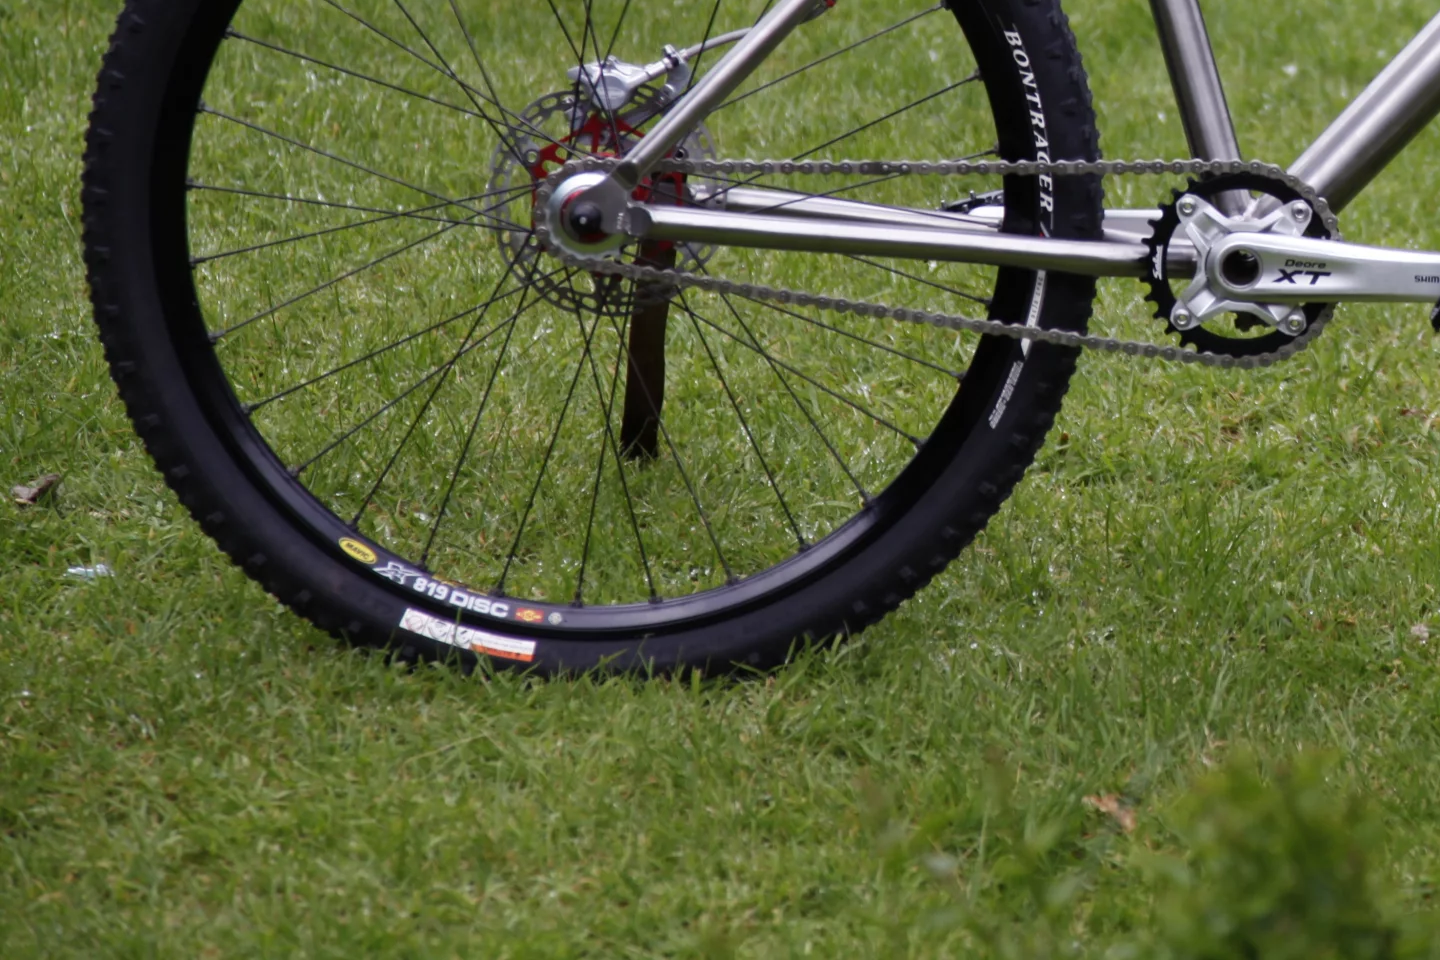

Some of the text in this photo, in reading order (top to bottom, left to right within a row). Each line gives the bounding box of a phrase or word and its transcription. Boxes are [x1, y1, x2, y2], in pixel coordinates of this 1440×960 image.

[1003, 29, 1054, 213] BONTRAGER
[1272, 268, 1332, 285] XT
[1284, 258, 1327, 269] Deore
[412, 576, 448, 601] 819
[448, 590, 509, 618] DISC
